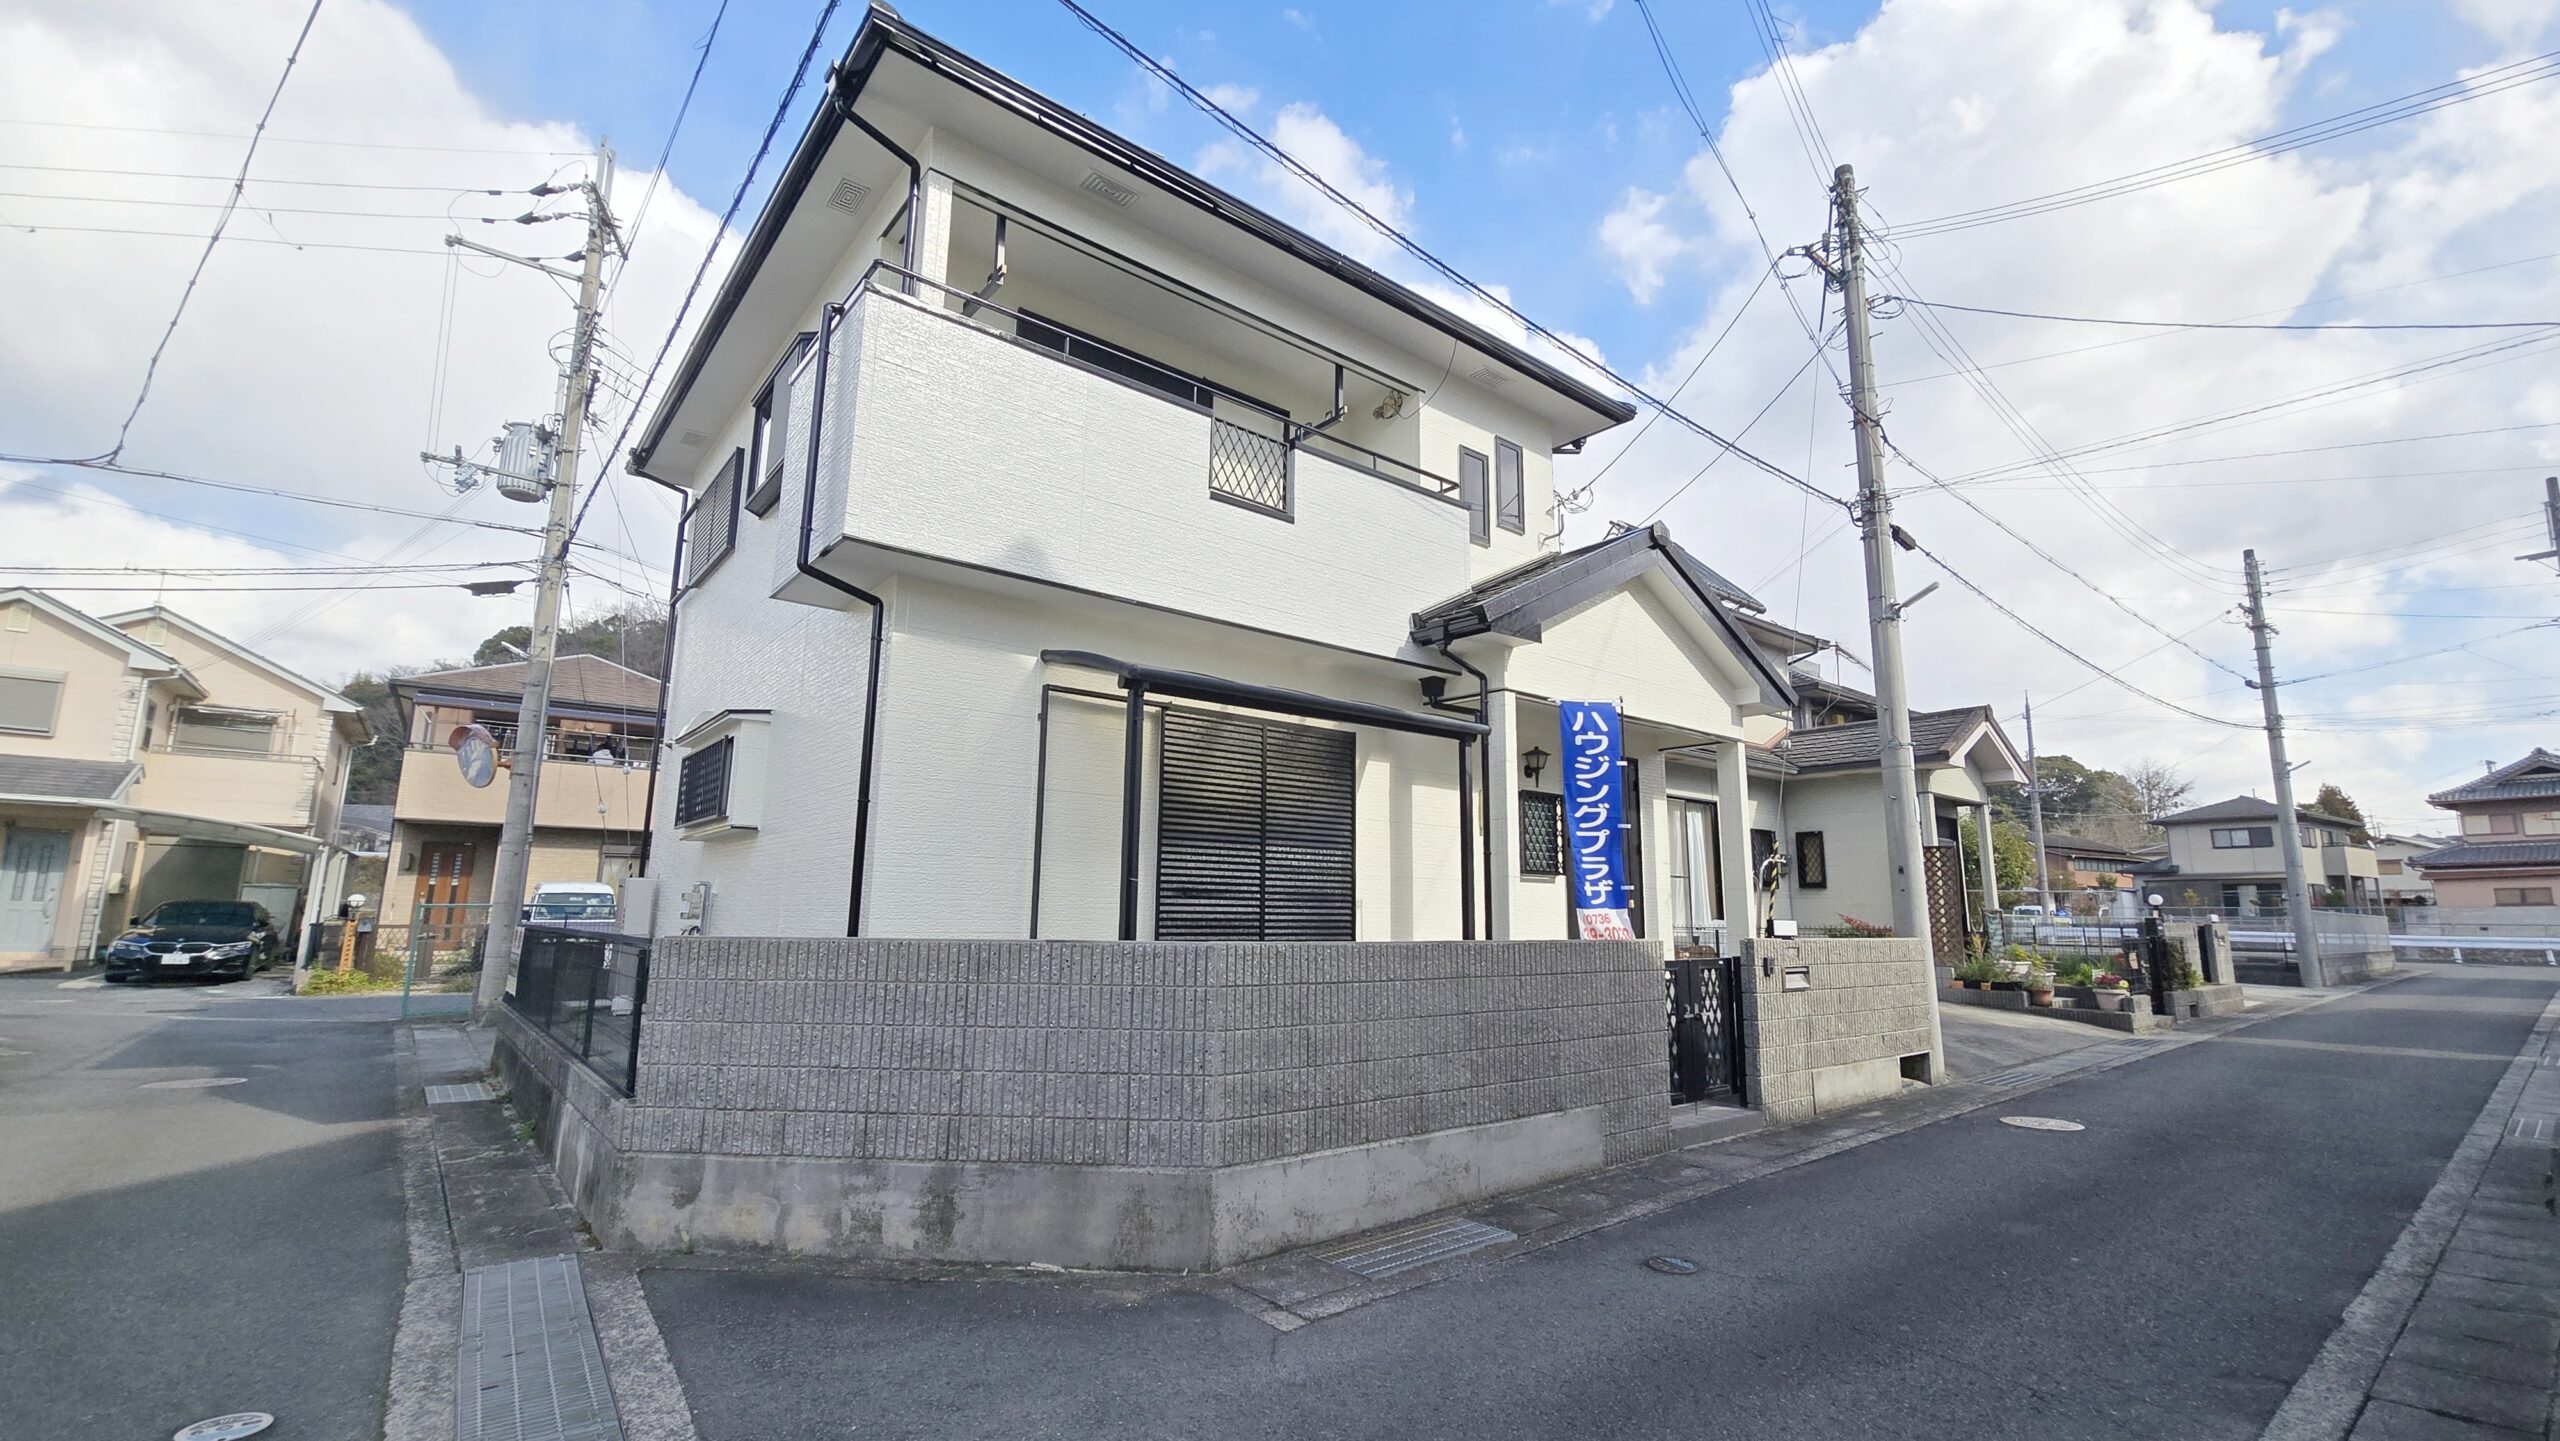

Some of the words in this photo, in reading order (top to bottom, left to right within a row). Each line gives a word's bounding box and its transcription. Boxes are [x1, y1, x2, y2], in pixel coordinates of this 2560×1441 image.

[1572, 711, 1613, 905] ハウジングプラザ
